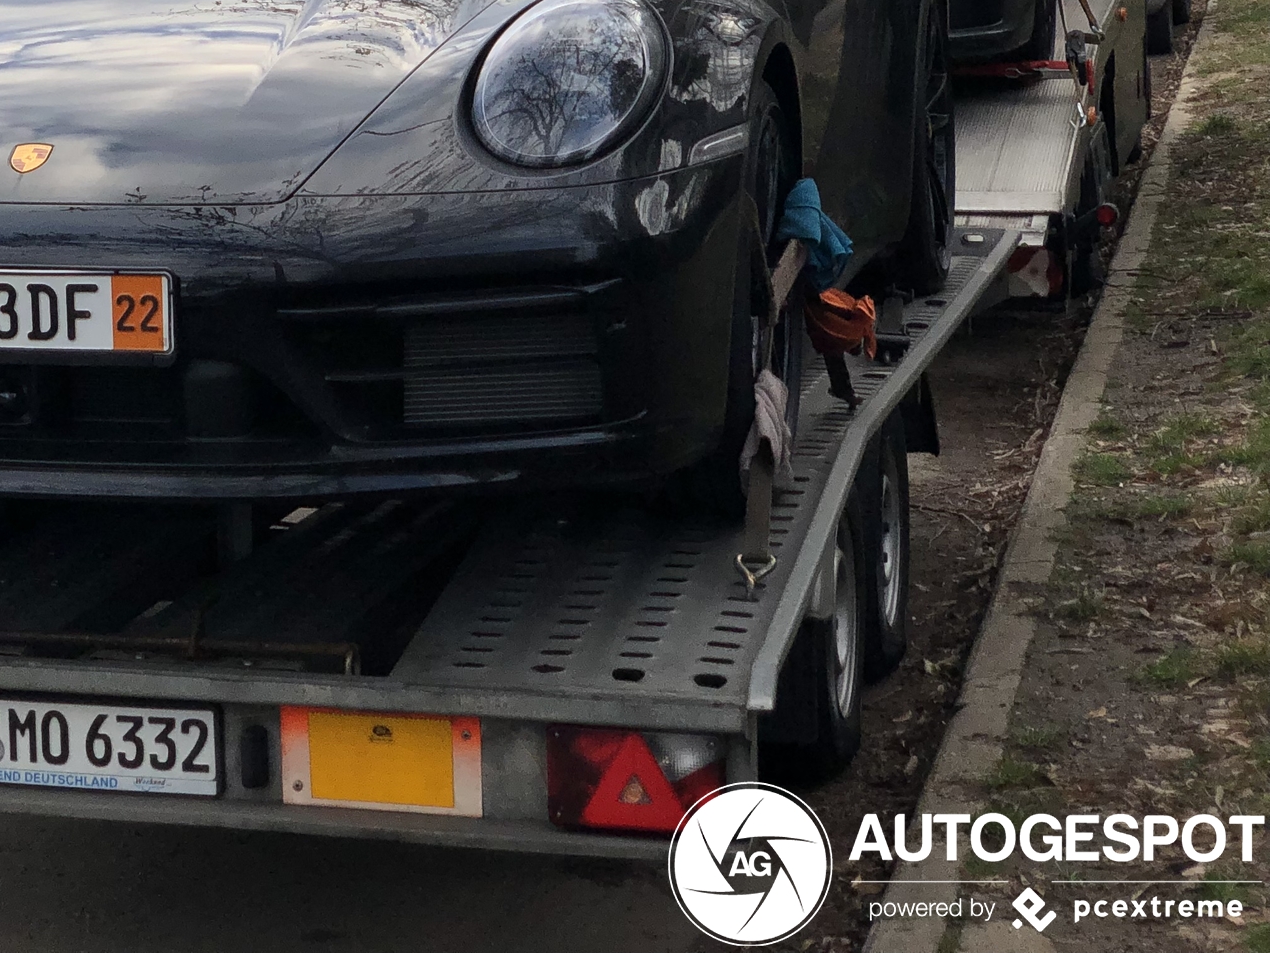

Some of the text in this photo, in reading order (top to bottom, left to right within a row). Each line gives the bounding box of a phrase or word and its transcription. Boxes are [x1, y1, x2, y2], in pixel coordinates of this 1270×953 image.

[116, 294, 160, 333] 22
[8, 708, 70, 765] MO
[85, 713, 210, 774] 6332
[23, 770, 119, 789] DEUTSCHLAND
